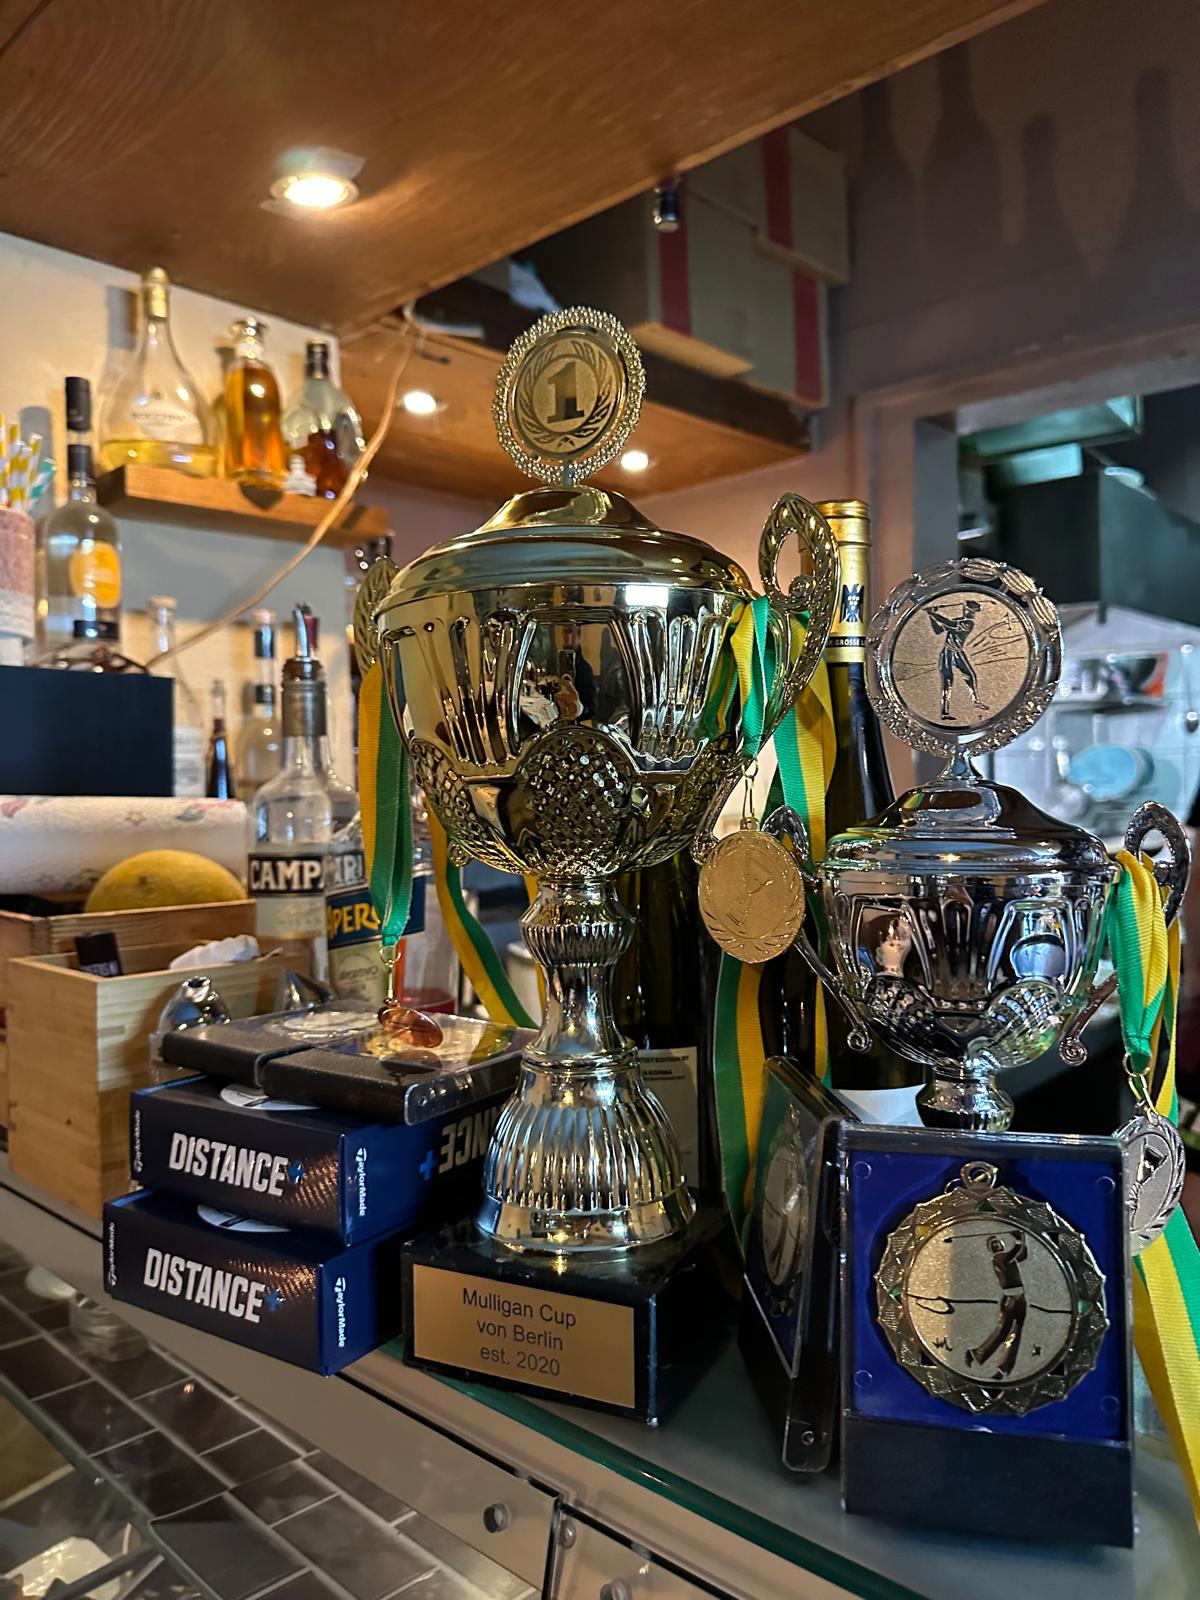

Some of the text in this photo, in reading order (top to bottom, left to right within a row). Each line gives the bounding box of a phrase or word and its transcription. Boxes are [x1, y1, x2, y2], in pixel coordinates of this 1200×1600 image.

[547, 361, 586, 424] 1
[250, 860, 324, 890] CAMP
[327, 903, 381, 941] APER
[355, 1148, 367, 1217] TaylorMade
[334, 1276, 346, 1348] TaylorMade
[463, 1288, 576, 1329] Mulligan Cup
[477, 1319, 563, 1351] von Berlin
[480, 1346, 561, 1377] est. 2020
